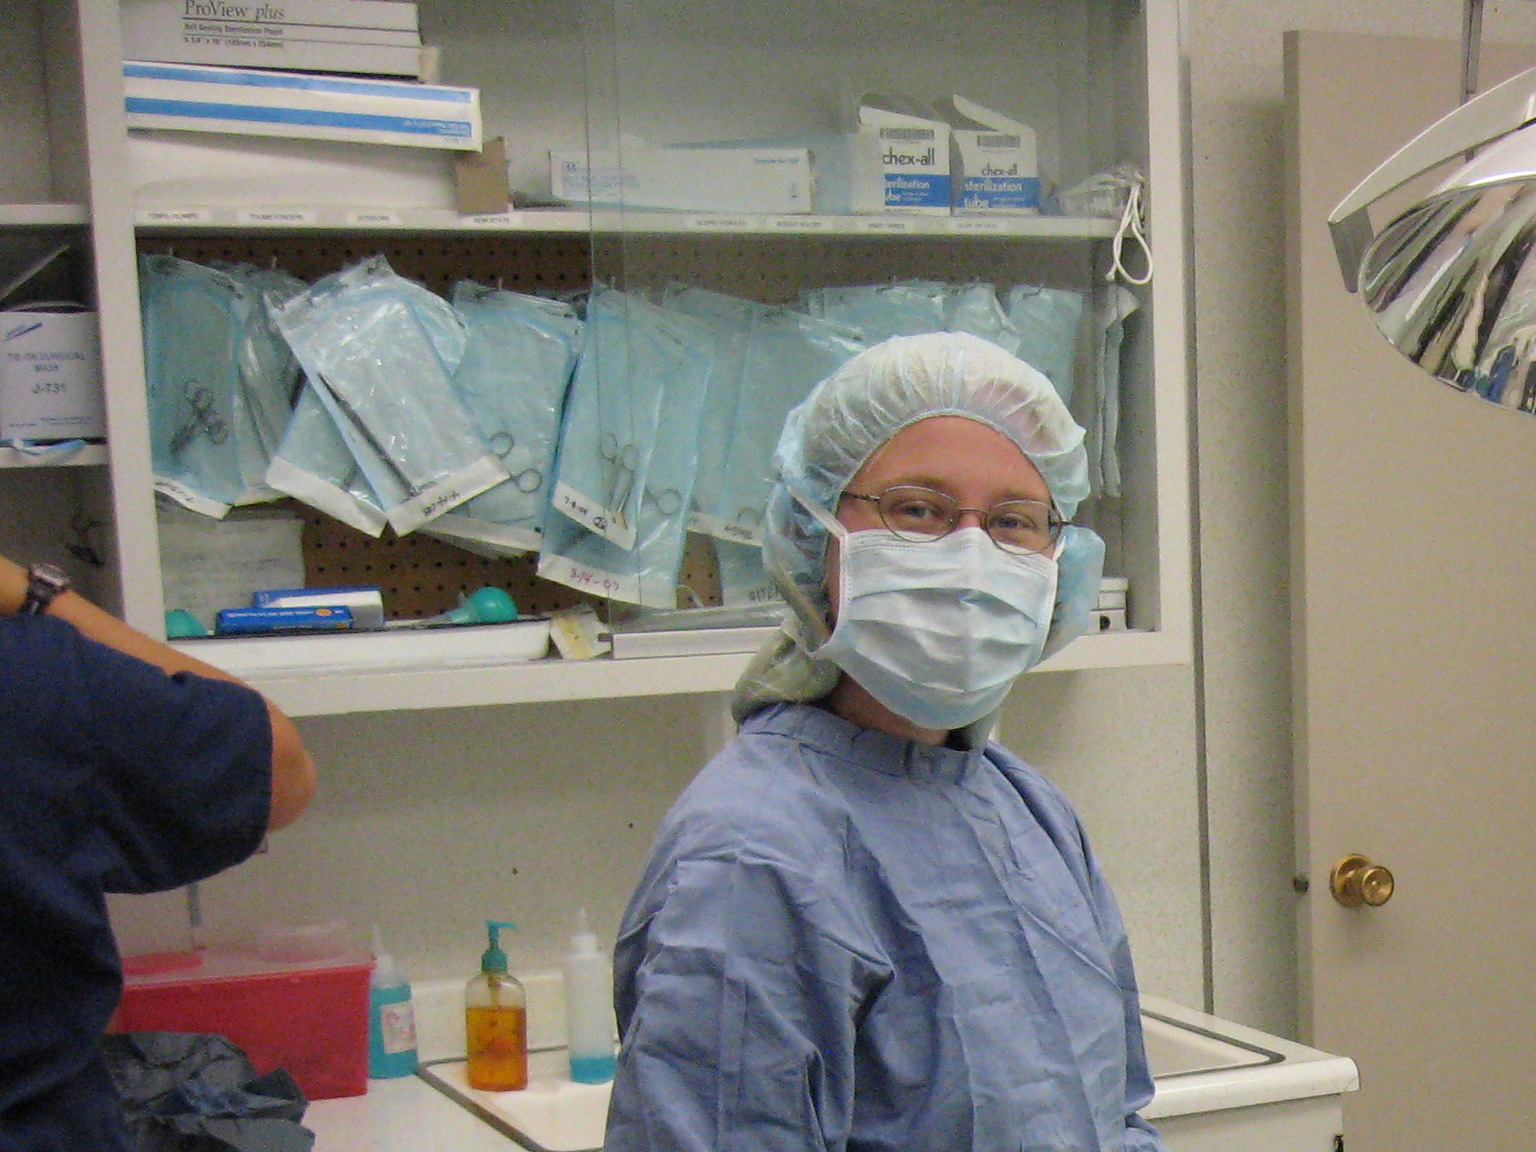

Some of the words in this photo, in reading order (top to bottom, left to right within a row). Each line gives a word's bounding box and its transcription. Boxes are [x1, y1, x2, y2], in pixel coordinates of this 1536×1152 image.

[184, 0, 248, 17] ProView
[256, 4, 284, 20] plus
[882, 146, 935, 166] chex-all
[981, 161, 1018, 176] chex-all
